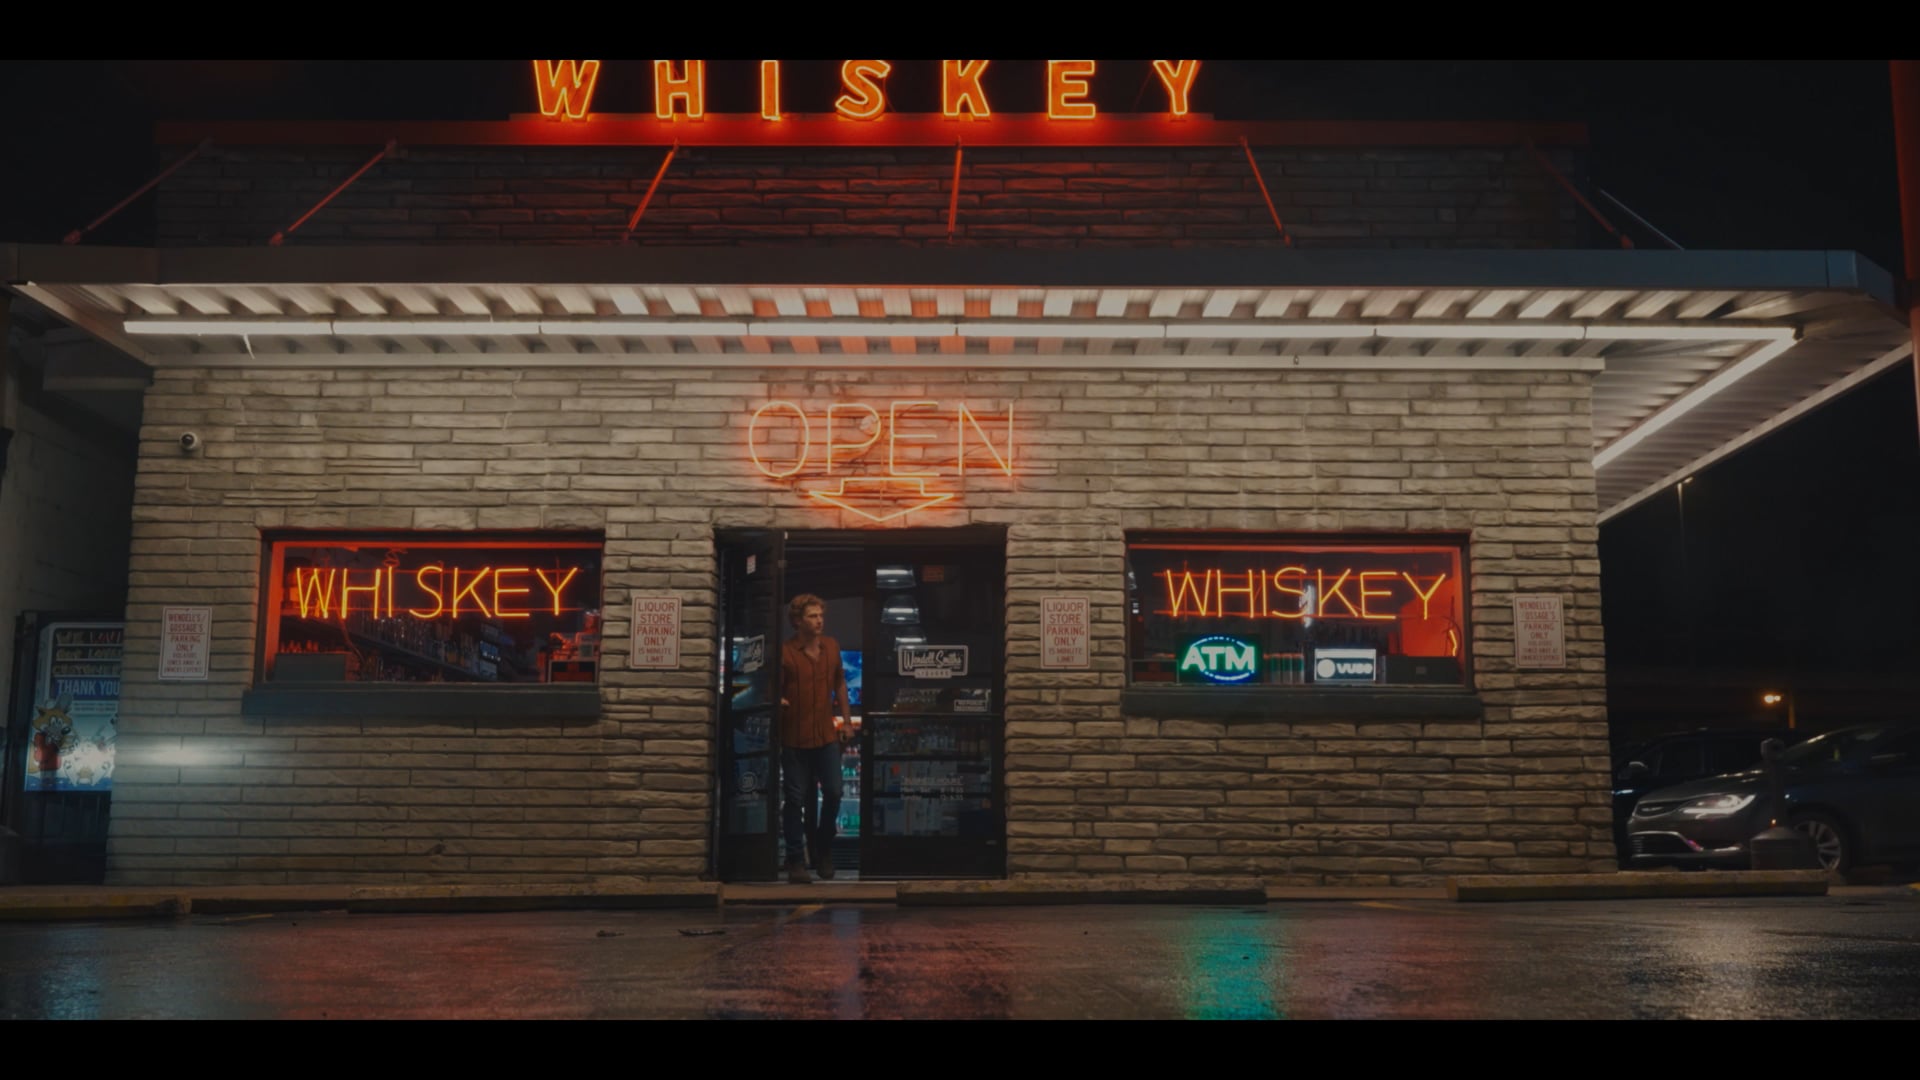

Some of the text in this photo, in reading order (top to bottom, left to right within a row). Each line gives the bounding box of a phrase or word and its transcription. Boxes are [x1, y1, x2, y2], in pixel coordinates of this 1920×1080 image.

[534, 60, 1202, 120] WHISKEY
[748, 400, 1014, 478] OPEN
[295, 566, 579, 619] WHISKEY
[1166, 567, 1447, 620] WHISKEY
[638, 602, 676, 612] LIQUOR
[1046, 602, 1084, 612] LIQUOR
[640, 614, 673, 624] STORE
[1049, 614, 1082, 624] STORE
[1519, 611, 1556, 620] OSSAGE'S
[637, 625, 676, 635] PARKING
[1046, 625, 1085, 635] PARKING
[1524, 623, 1554, 631] PARKING
[170, 634, 201, 643] PARKING
[644, 637, 667, 646] ONLY
[1055, 637, 1077, 646] ONLY
[646, 647, 672, 655] MINUTE
[1056, 647, 1082, 655] MINUTE
[645, 655, 665, 663] LIMIT
[1057, 655, 1074, 663] LIMIT
[1181, 646, 1256, 671] ATM
[56, 679, 120, 696] THANK YOU
